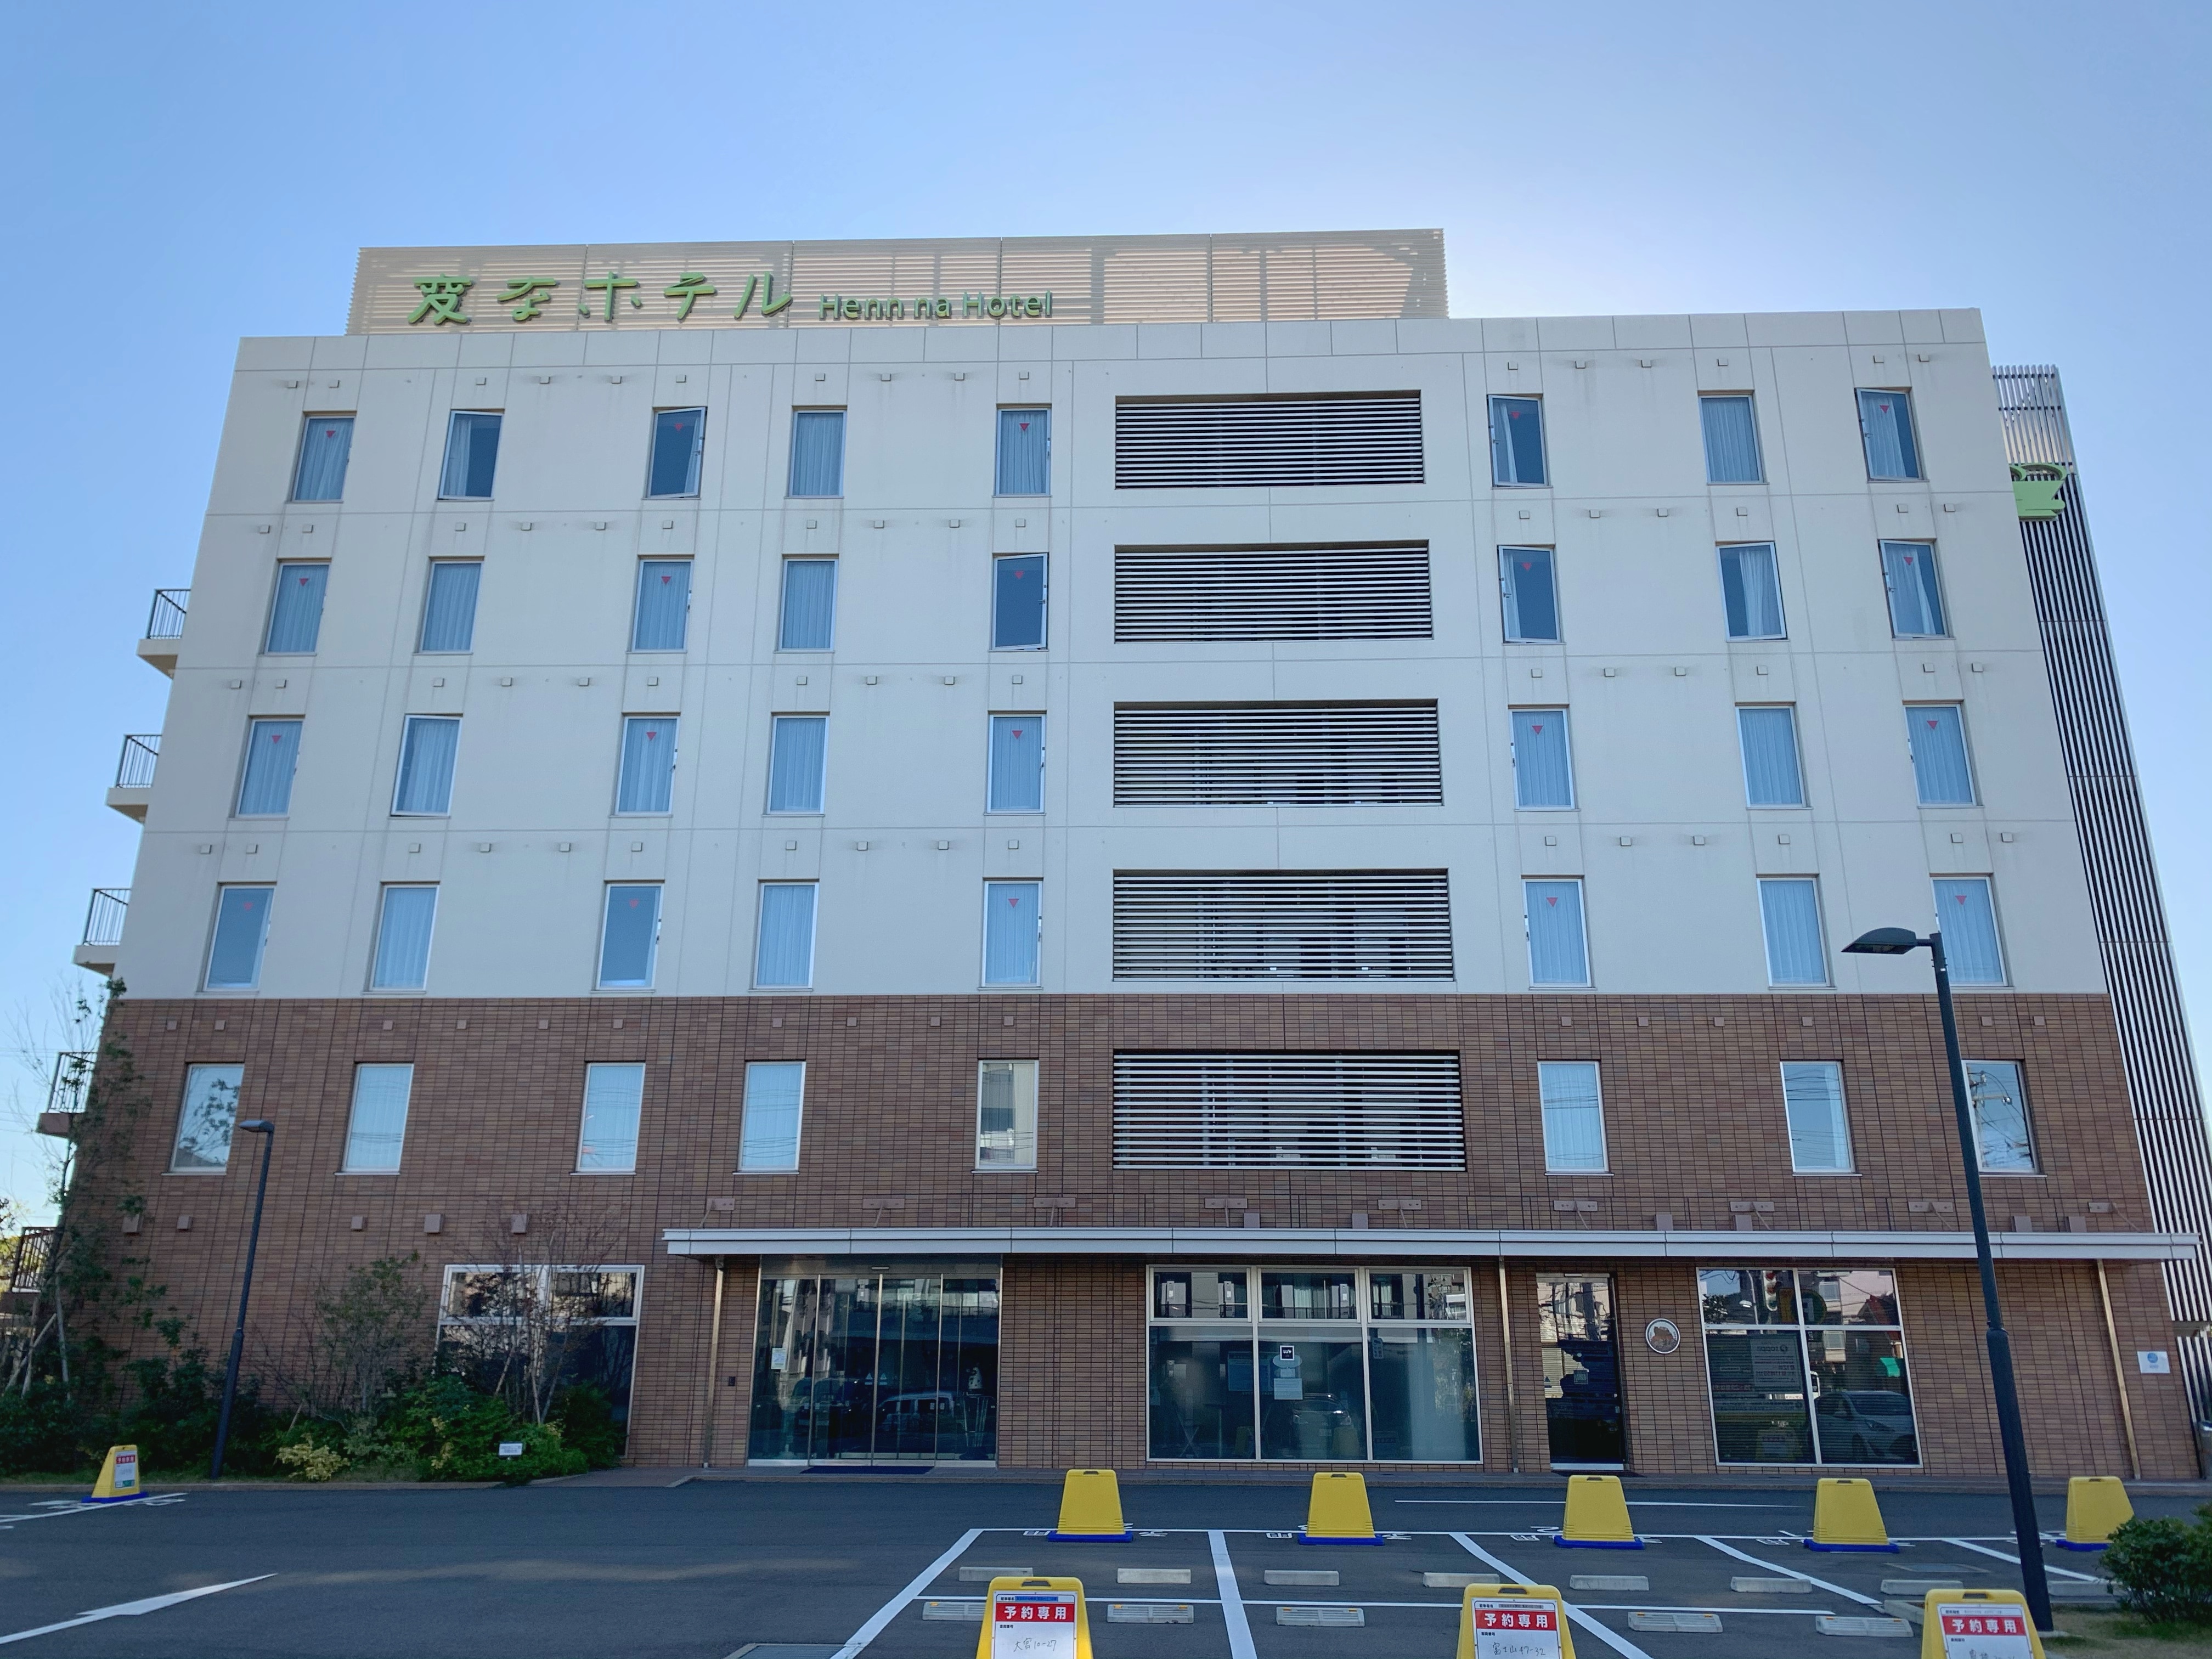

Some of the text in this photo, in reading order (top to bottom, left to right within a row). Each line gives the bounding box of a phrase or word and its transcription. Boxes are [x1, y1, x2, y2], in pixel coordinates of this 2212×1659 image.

[407, 272, 792, 324] 変なホテル
[819, 290, 1052, 320] Henn na Hotel
[1004, 1606, 1066, 1620] 予約専用
[1484, 1613, 1548, 1628] 予約専用
[1952, 1619, 2017, 1633] 予約専用
